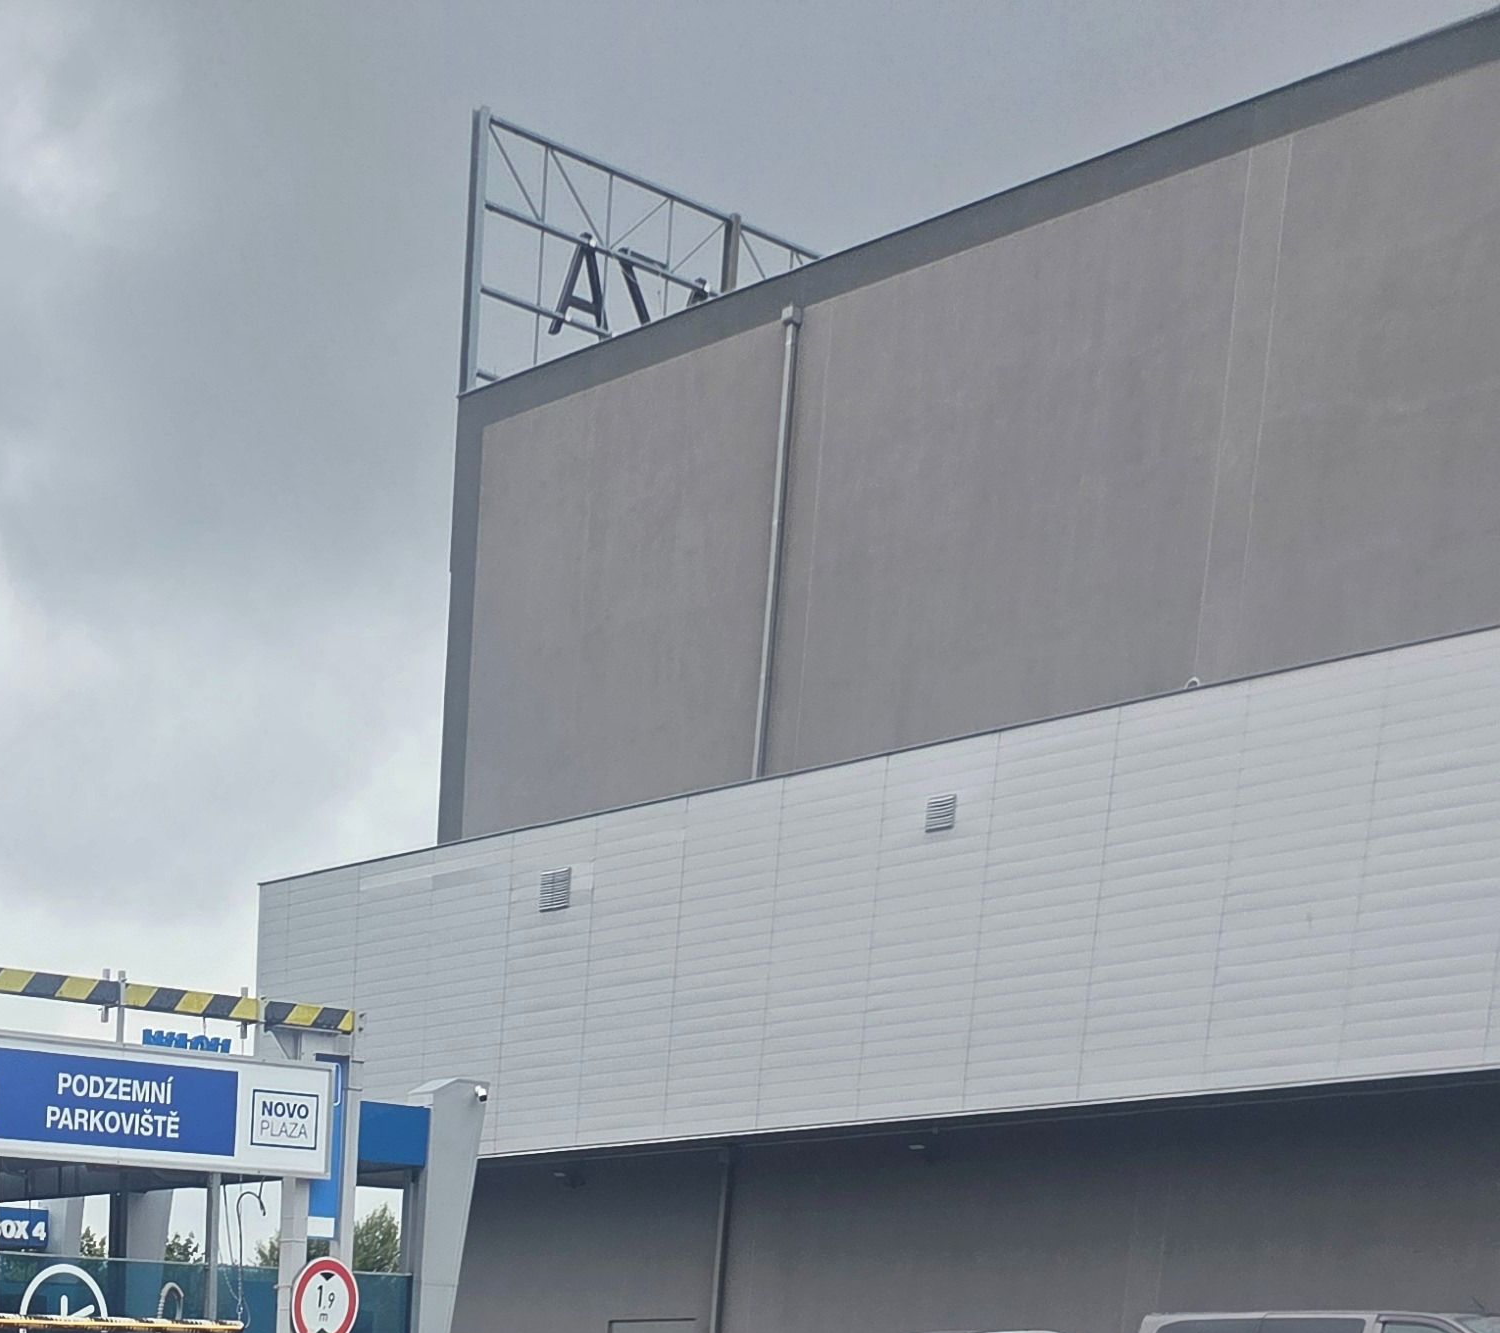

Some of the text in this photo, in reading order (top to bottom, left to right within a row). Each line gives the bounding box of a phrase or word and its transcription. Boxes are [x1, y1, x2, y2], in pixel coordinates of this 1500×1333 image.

[57, 1072, 174, 1104] PODZEMNÍ
[261, 1100, 309, 1119] NOVO
[46, 1105, 180, 1138] PARKOVIŠTĚ
[259, 1120, 309, 1139] PLAZA
[32, 1221, 46, 1241] 4
[319, 1312, 329, 1322] m
